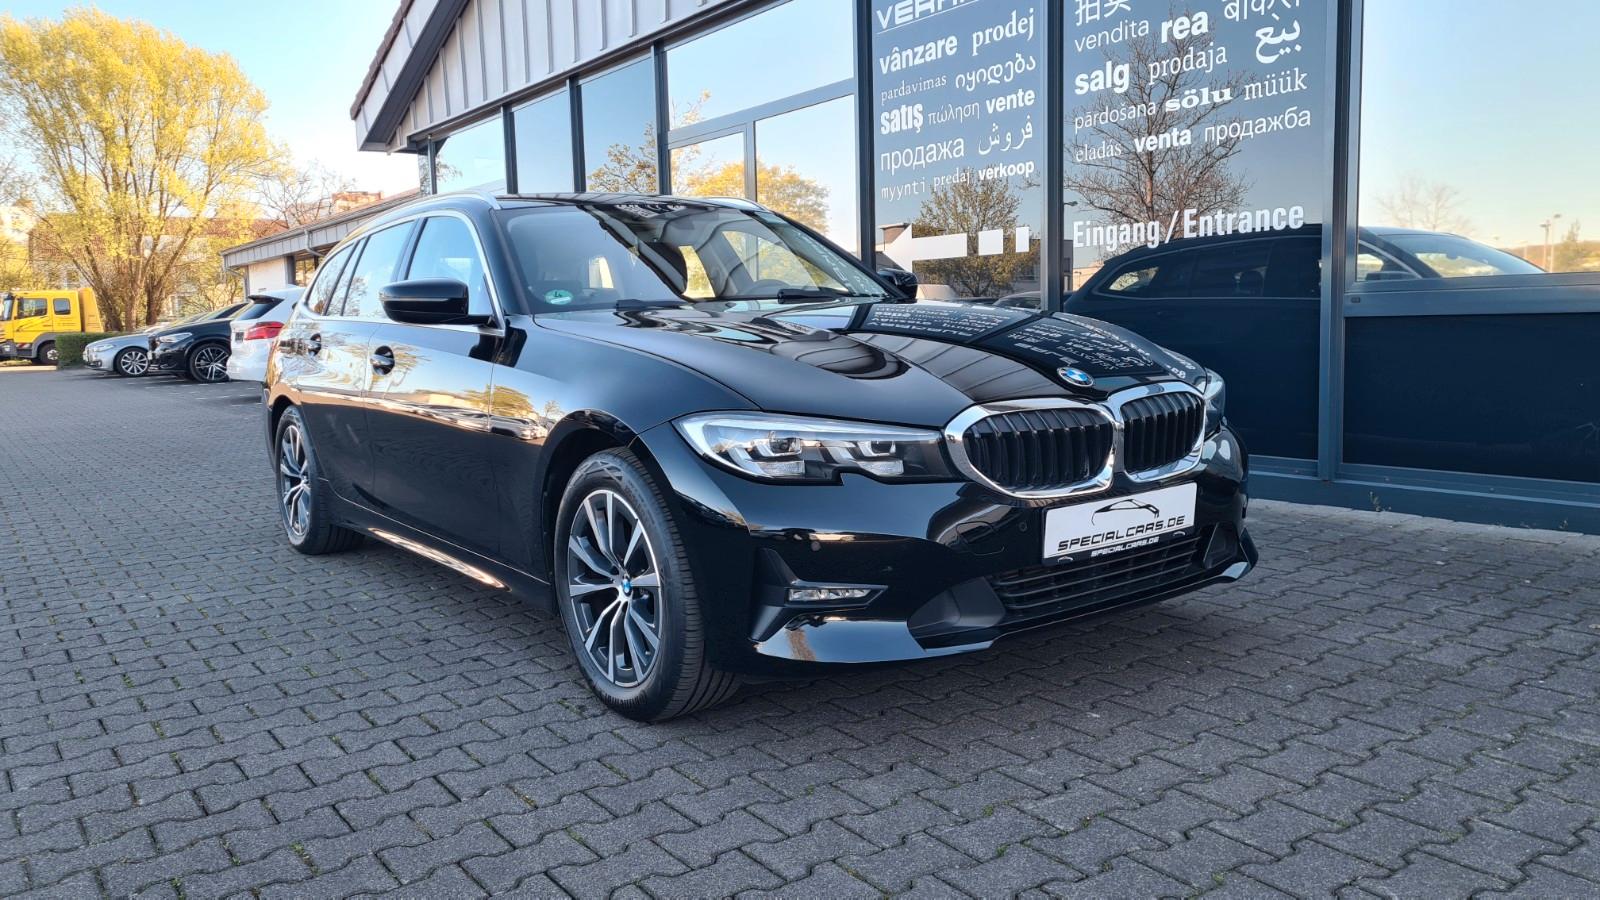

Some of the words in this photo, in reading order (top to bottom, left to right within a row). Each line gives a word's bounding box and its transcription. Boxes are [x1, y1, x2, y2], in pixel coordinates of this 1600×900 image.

[879, 35, 958, 74] vânzare
[972, 8, 1034, 56] prodej
[1074, 19, 1149, 52] vendita
[1161, 11, 1209, 43] rea
[955, 53, 1036, 92] იყიდება
[1074, 61, 1130, 95] salg
[1149, 42, 1228, 85] prodaja
[881, 75, 947, 106] pardavimas
[986, 88, 1035, 114] vente
[1074, 102, 1157, 134] pārdošana
[1165, 88, 1233, 112] sölu
[1244, 67, 1308, 101] müük
[881, 103, 924, 134] satış
[928, 102, 980, 125] πώληση
[1204, 106, 1311, 145] продажба
[978, 115, 1033, 155] فروش
[1075, 139, 1123, 162] eladás
[1134, 128, 1192, 152] venta
[881, 138, 965, 176] продажа
[881, 177, 926, 202] myynti
[933, 166, 971, 191] predaj
[978, 161, 1035, 181] verkoop
[1057, 515, 1186, 551] SPECIALCARS.DE
